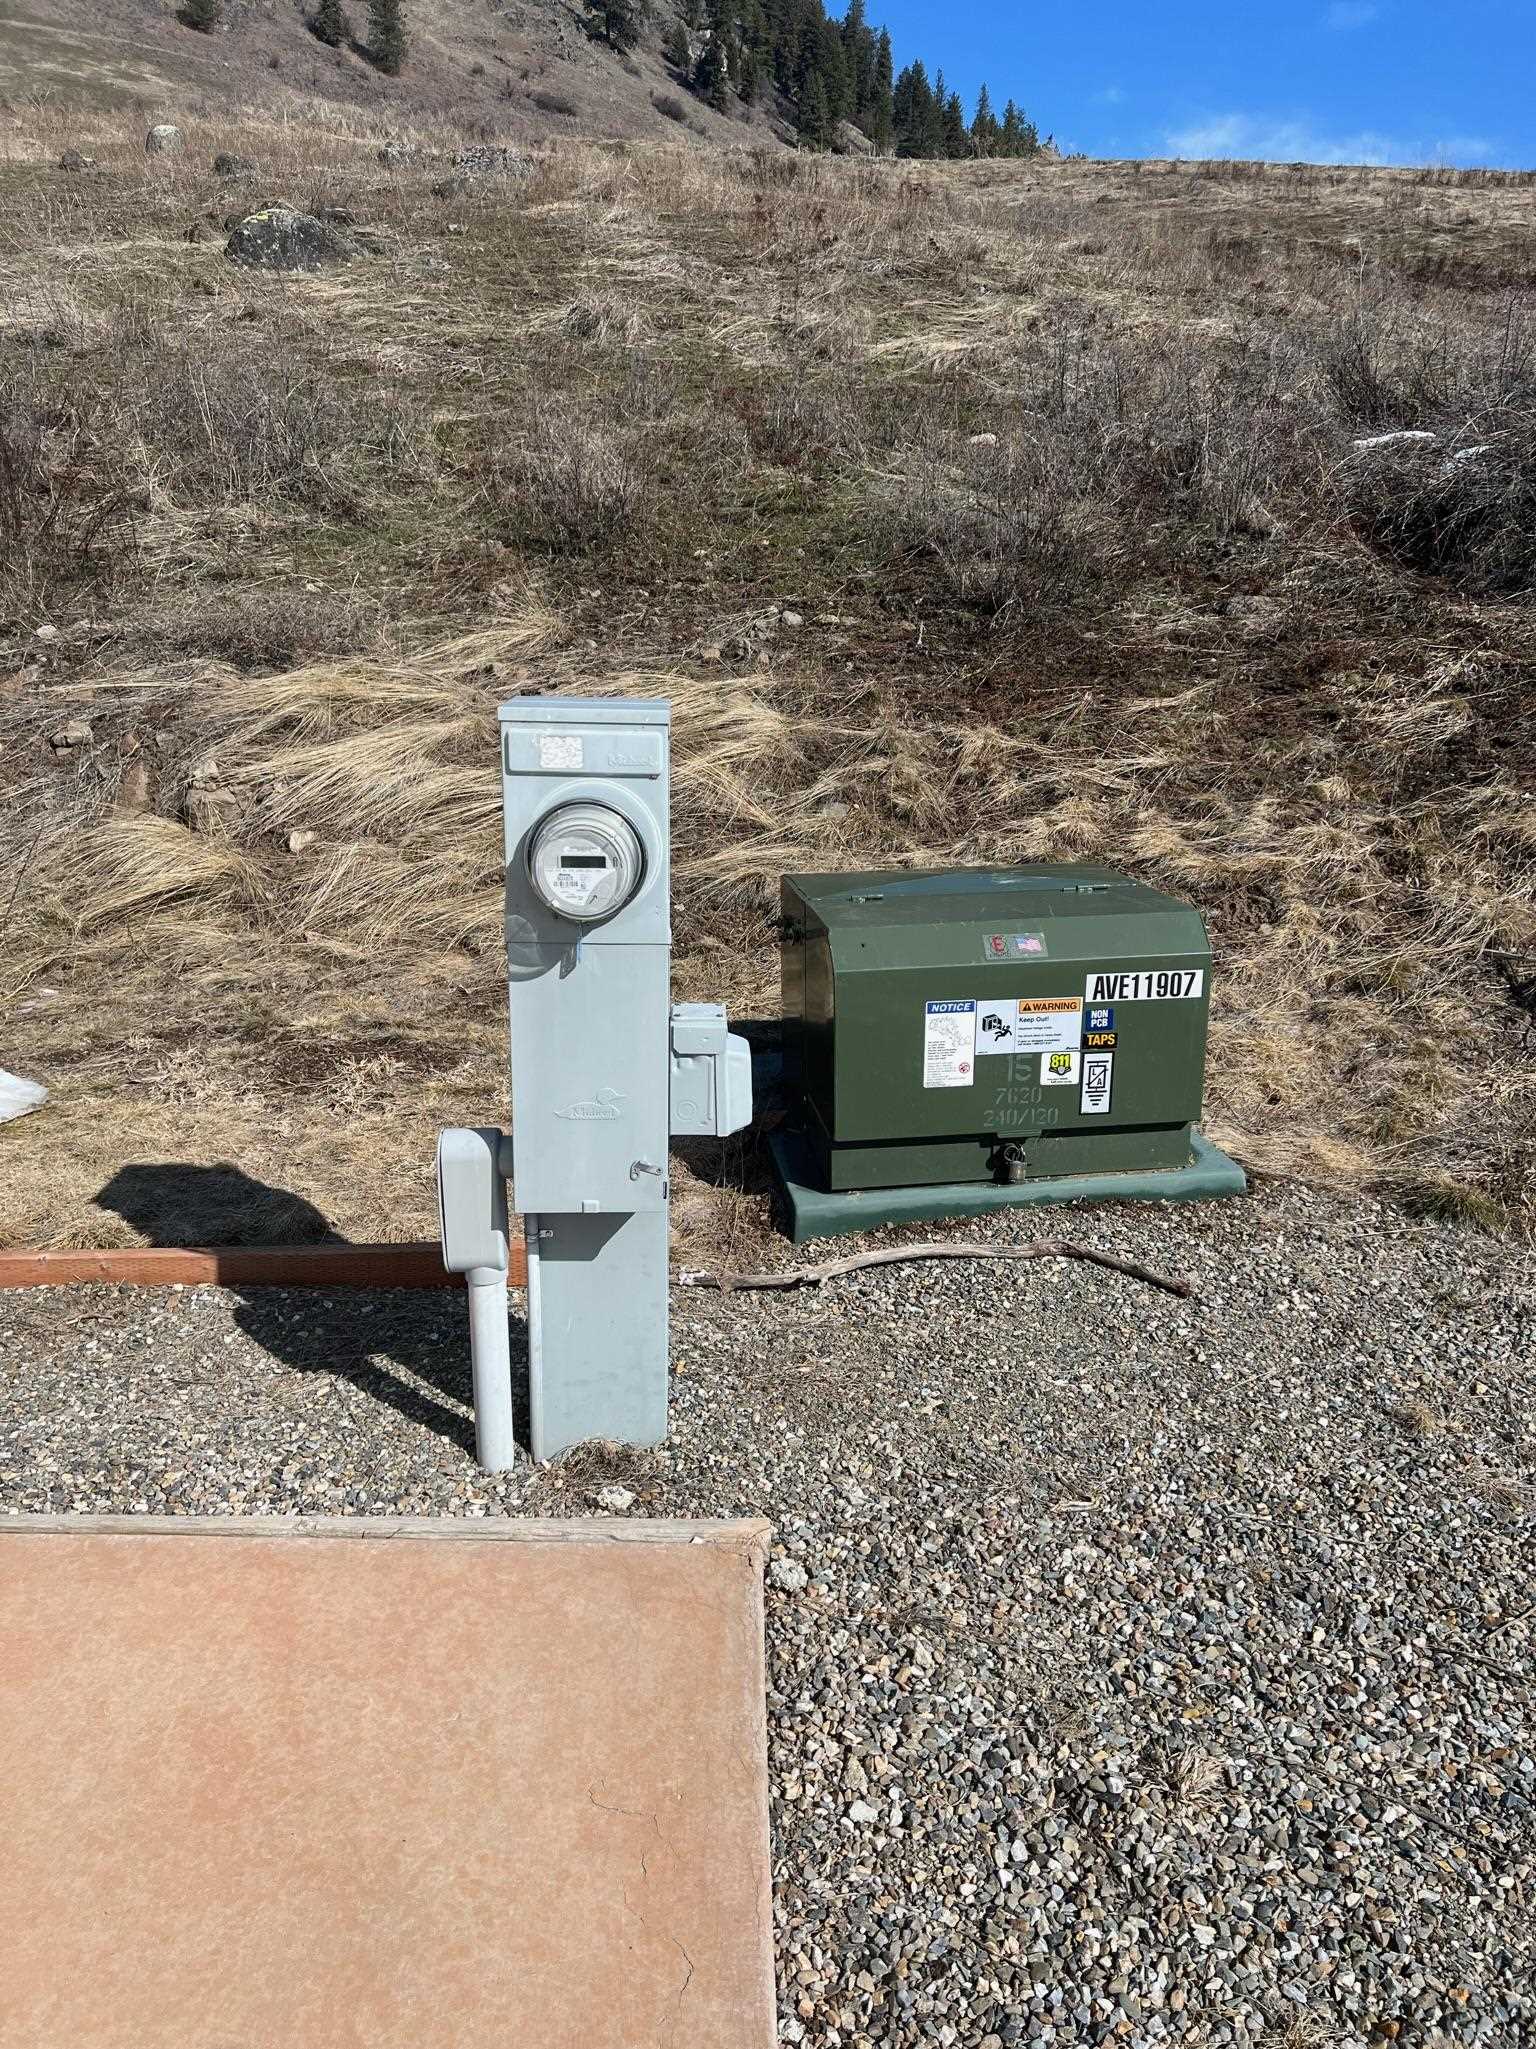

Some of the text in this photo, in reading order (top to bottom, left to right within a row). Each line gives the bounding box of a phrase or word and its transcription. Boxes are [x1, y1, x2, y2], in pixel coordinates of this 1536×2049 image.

[1092, 972, 1196, 1001] AVE11907
[931, 1003, 971, 1013] NOTICE
[1032, 1002, 1078, 1011] WARNING
[1091, 1009, 1109, 1019] NON
[1090, 1018, 1109, 1028] PCB
[1087, 1034, 1116, 1046] TAPS
[1051, 1054, 1071, 1068] 811
